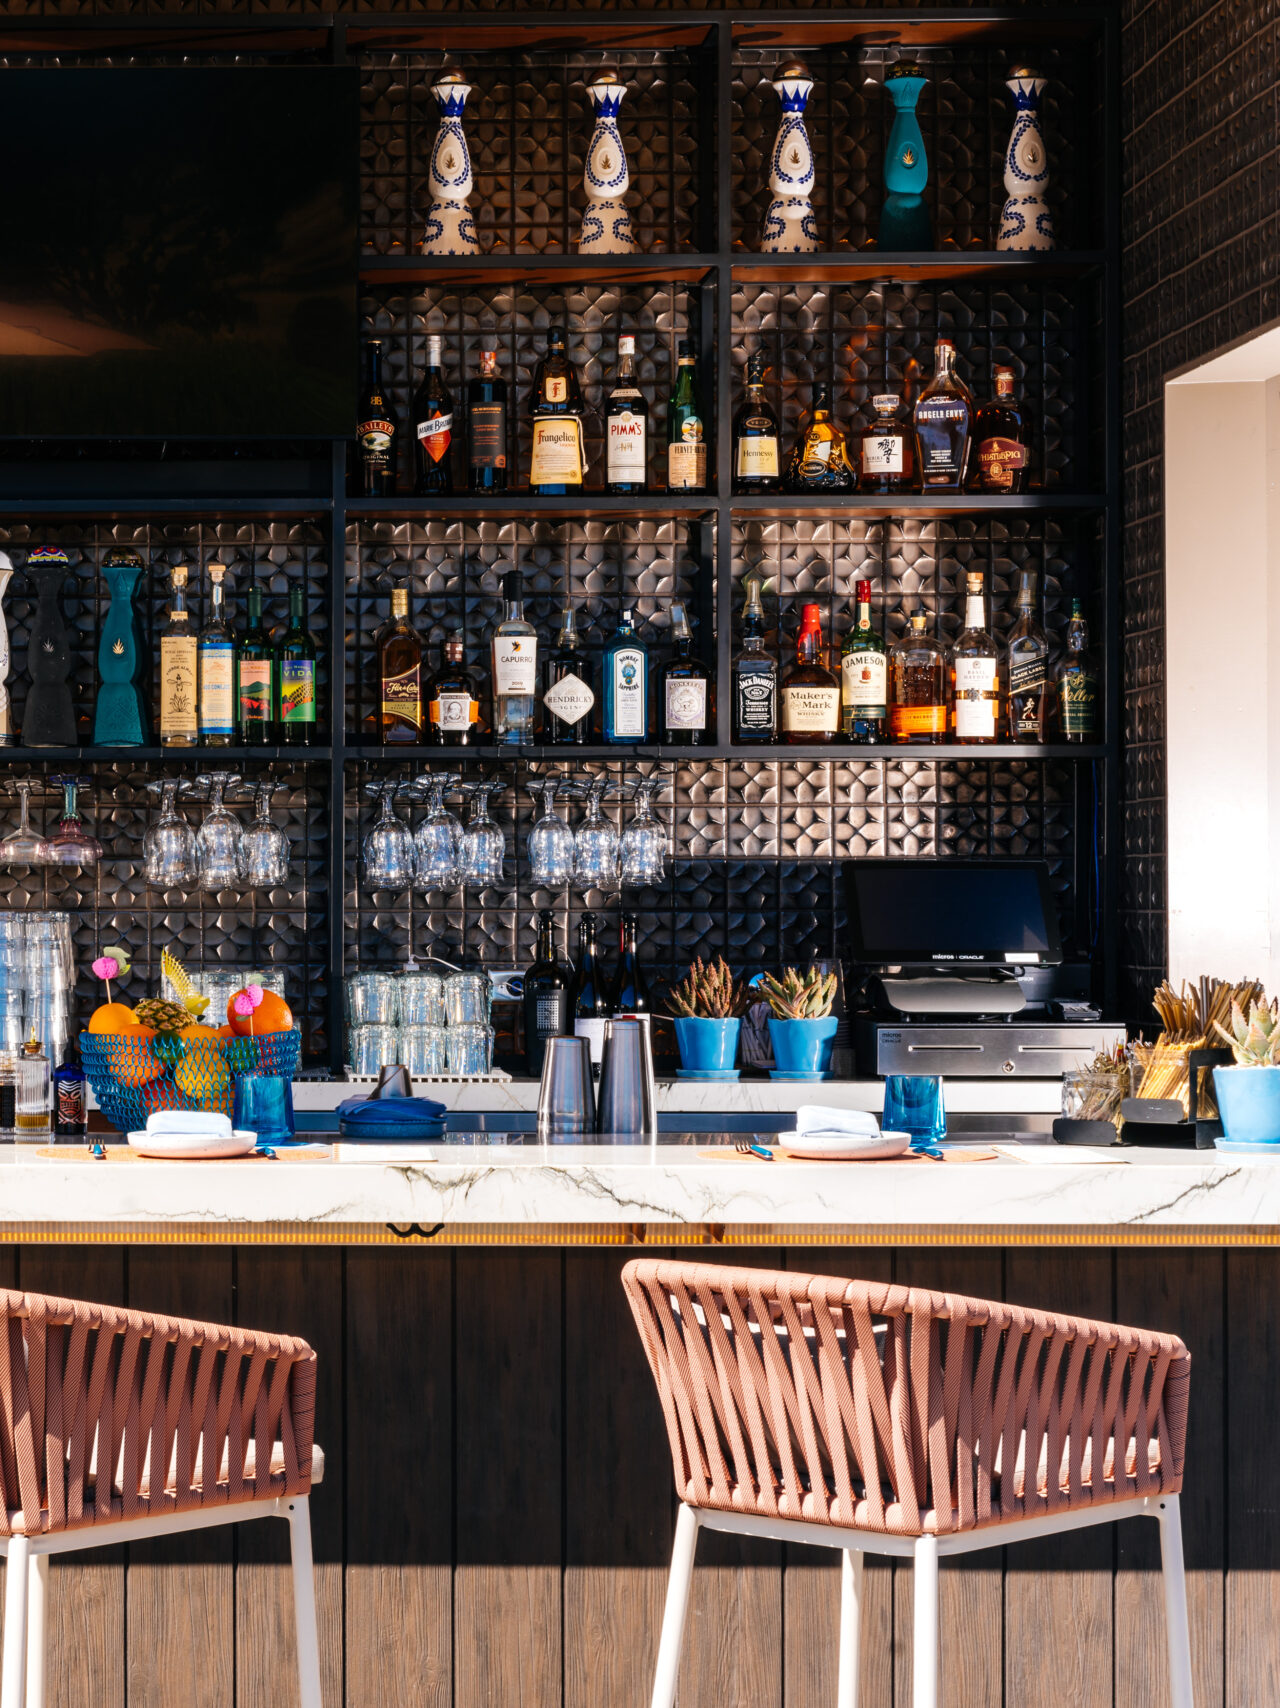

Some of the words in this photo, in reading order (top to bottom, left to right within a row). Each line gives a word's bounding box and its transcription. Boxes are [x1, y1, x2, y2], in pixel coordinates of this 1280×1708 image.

[359, 421, 393, 435] BAILEYS
[611, 422, 642, 436] PIMM'S
[537, 429, 576, 445] Frangelico
[743, 450, 774, 458] Hennessy
[618, 655, 639, 664] BOMBAY
[845, 656, 884, 669] JAMESON
[618, 682, 640, 691] SAPPHIRE
[790, 692, 833, 700] Maker's
[802, 701, 833, 709] Mark
